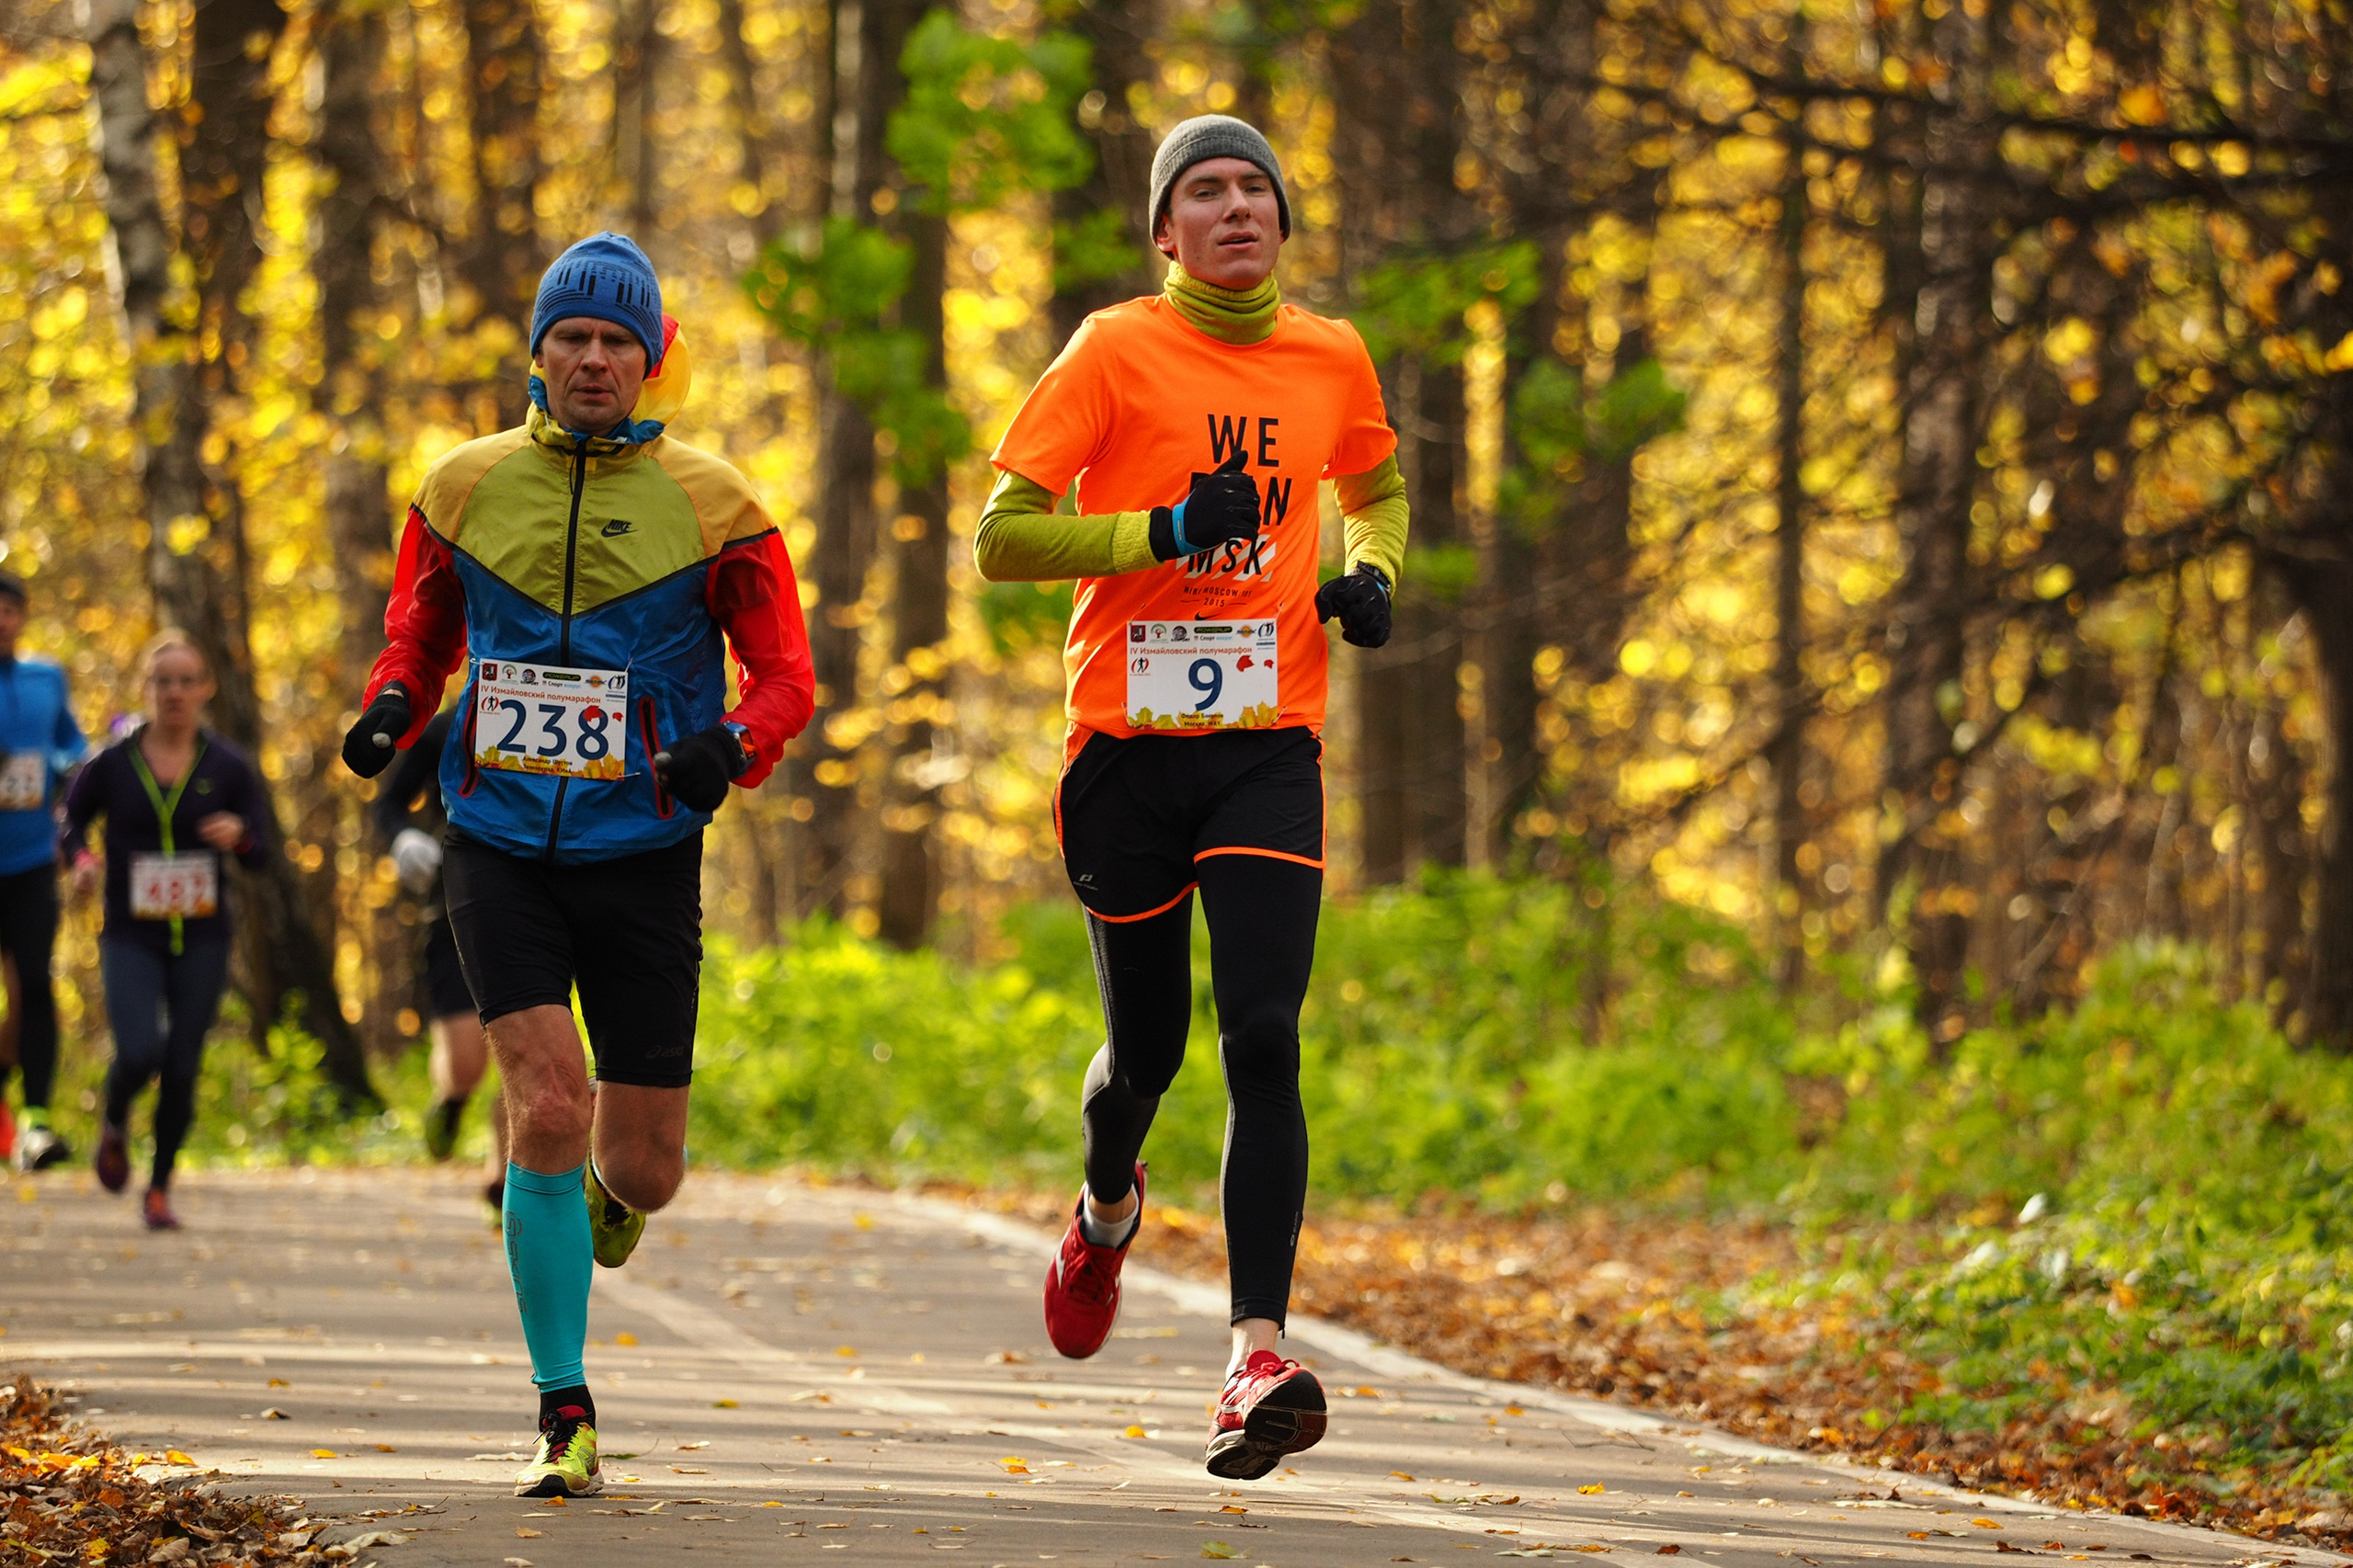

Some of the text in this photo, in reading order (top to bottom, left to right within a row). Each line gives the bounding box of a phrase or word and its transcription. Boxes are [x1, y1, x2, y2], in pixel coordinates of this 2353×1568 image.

[1208, 414, 1279, 468] WE
[608, 519, 632, 532] NIKE
[1188, 539, 1267, 575] MSK
[1203, 585, 1237, 597] MOSCOW
[1204, 597, 1225, 608] 2015
[1140, 646, 1198, 655] Измайловский
[1199, 646, 1253, 656] полумарафон
[545, 673, 580, 681] POWERUP
[548, 680, 563, 688] Спорт
[1188, 658, 1223, 711] 9
[481, 685, 489, 693] IV
[491, 686, 545, 699] Измайловский
[547, 694, 601, 705] полумарафон
[496, 699, 609, 761] 238
